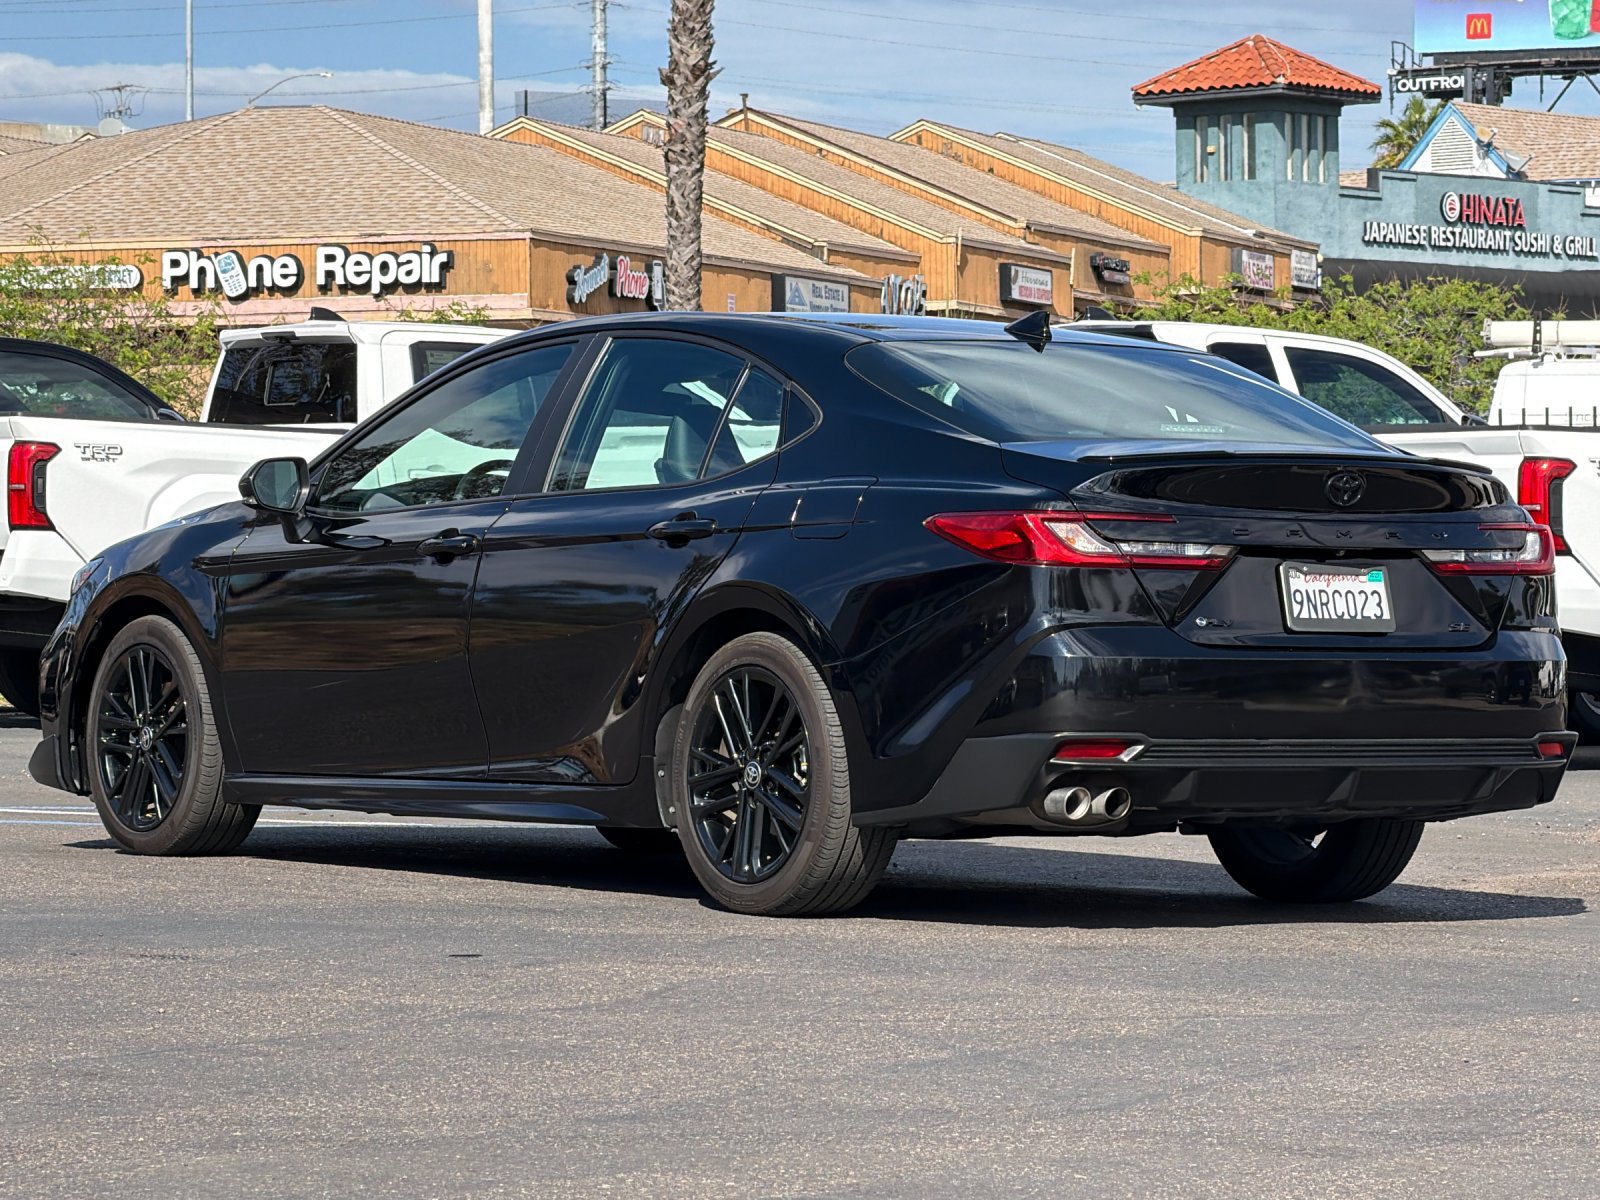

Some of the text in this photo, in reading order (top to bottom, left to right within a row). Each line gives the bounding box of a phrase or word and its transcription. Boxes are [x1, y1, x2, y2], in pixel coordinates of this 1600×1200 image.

[1397, 76, 1465, 92] OUTFRO
[1461, 193, 1526, 227] HINATA
[1363, 221, 1599, 257] JAPANESE RESTAURANT SUSHI & GRILL
[316, 243, 450, 296] Repair
[616, 255, 649, 300] Phone
[74, 442, 123, 459] TRD
[1303, 572, 1368, 589] California
[1292, 588, 1384, 620] 9NRC023
